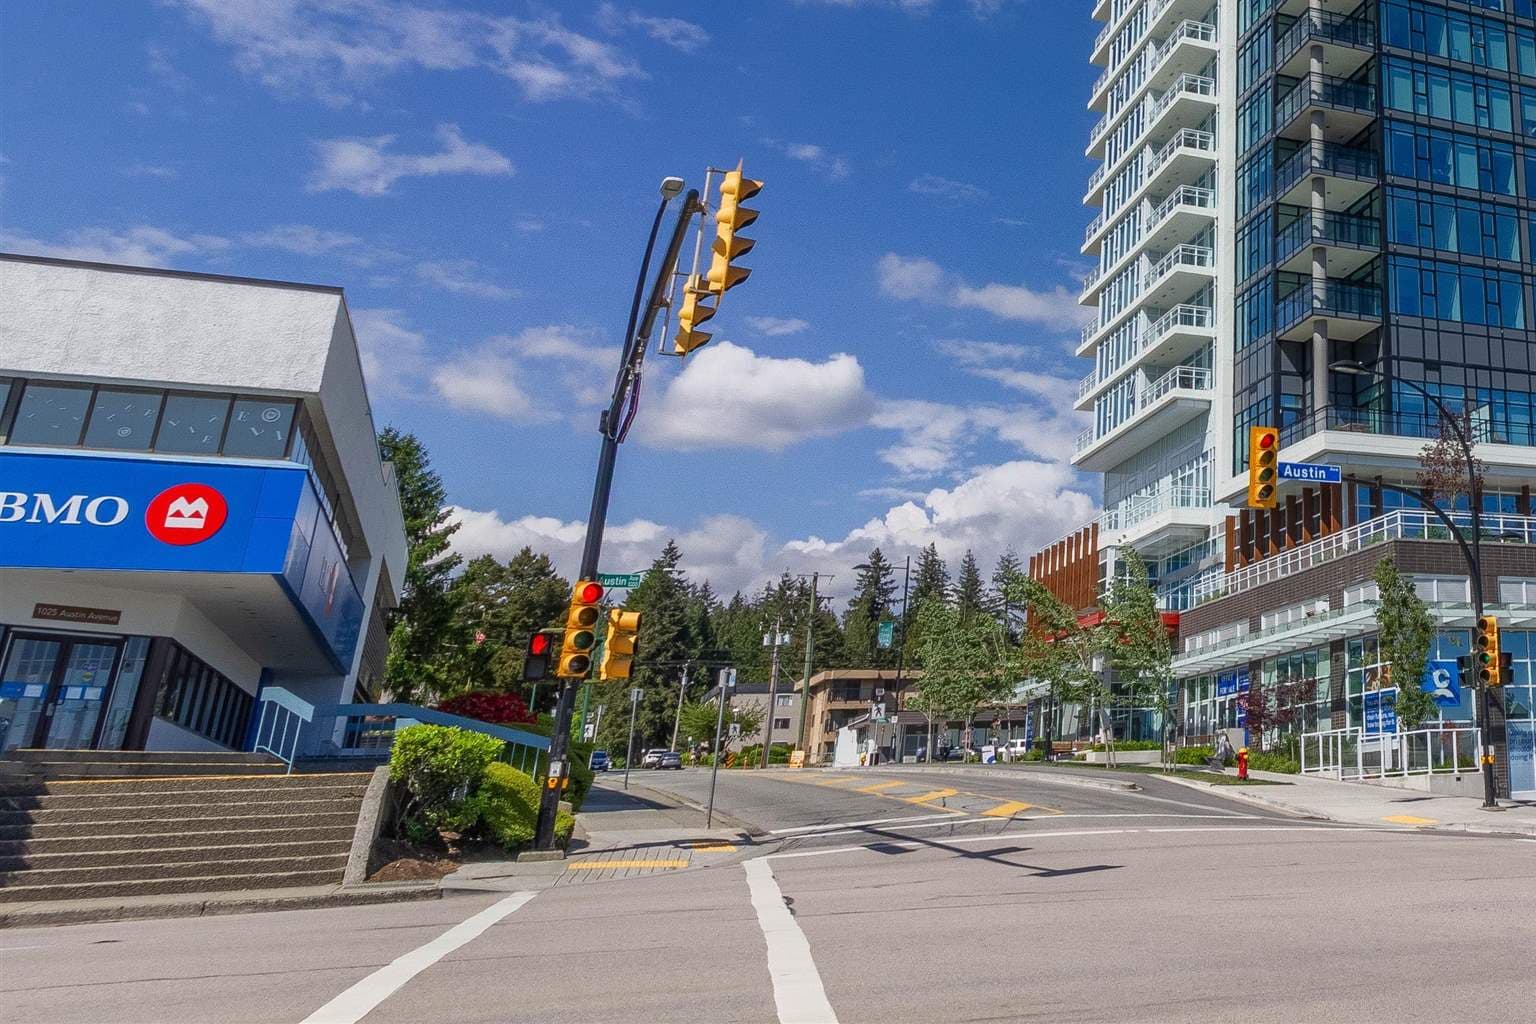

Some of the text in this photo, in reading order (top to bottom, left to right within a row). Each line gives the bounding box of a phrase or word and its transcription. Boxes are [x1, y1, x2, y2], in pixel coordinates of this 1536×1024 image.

[1284, 464, 1326, 479] Austin
[0, 492, 129, 526] BMO
[38, 607, 118, 622] 1025 Austin Avenue
